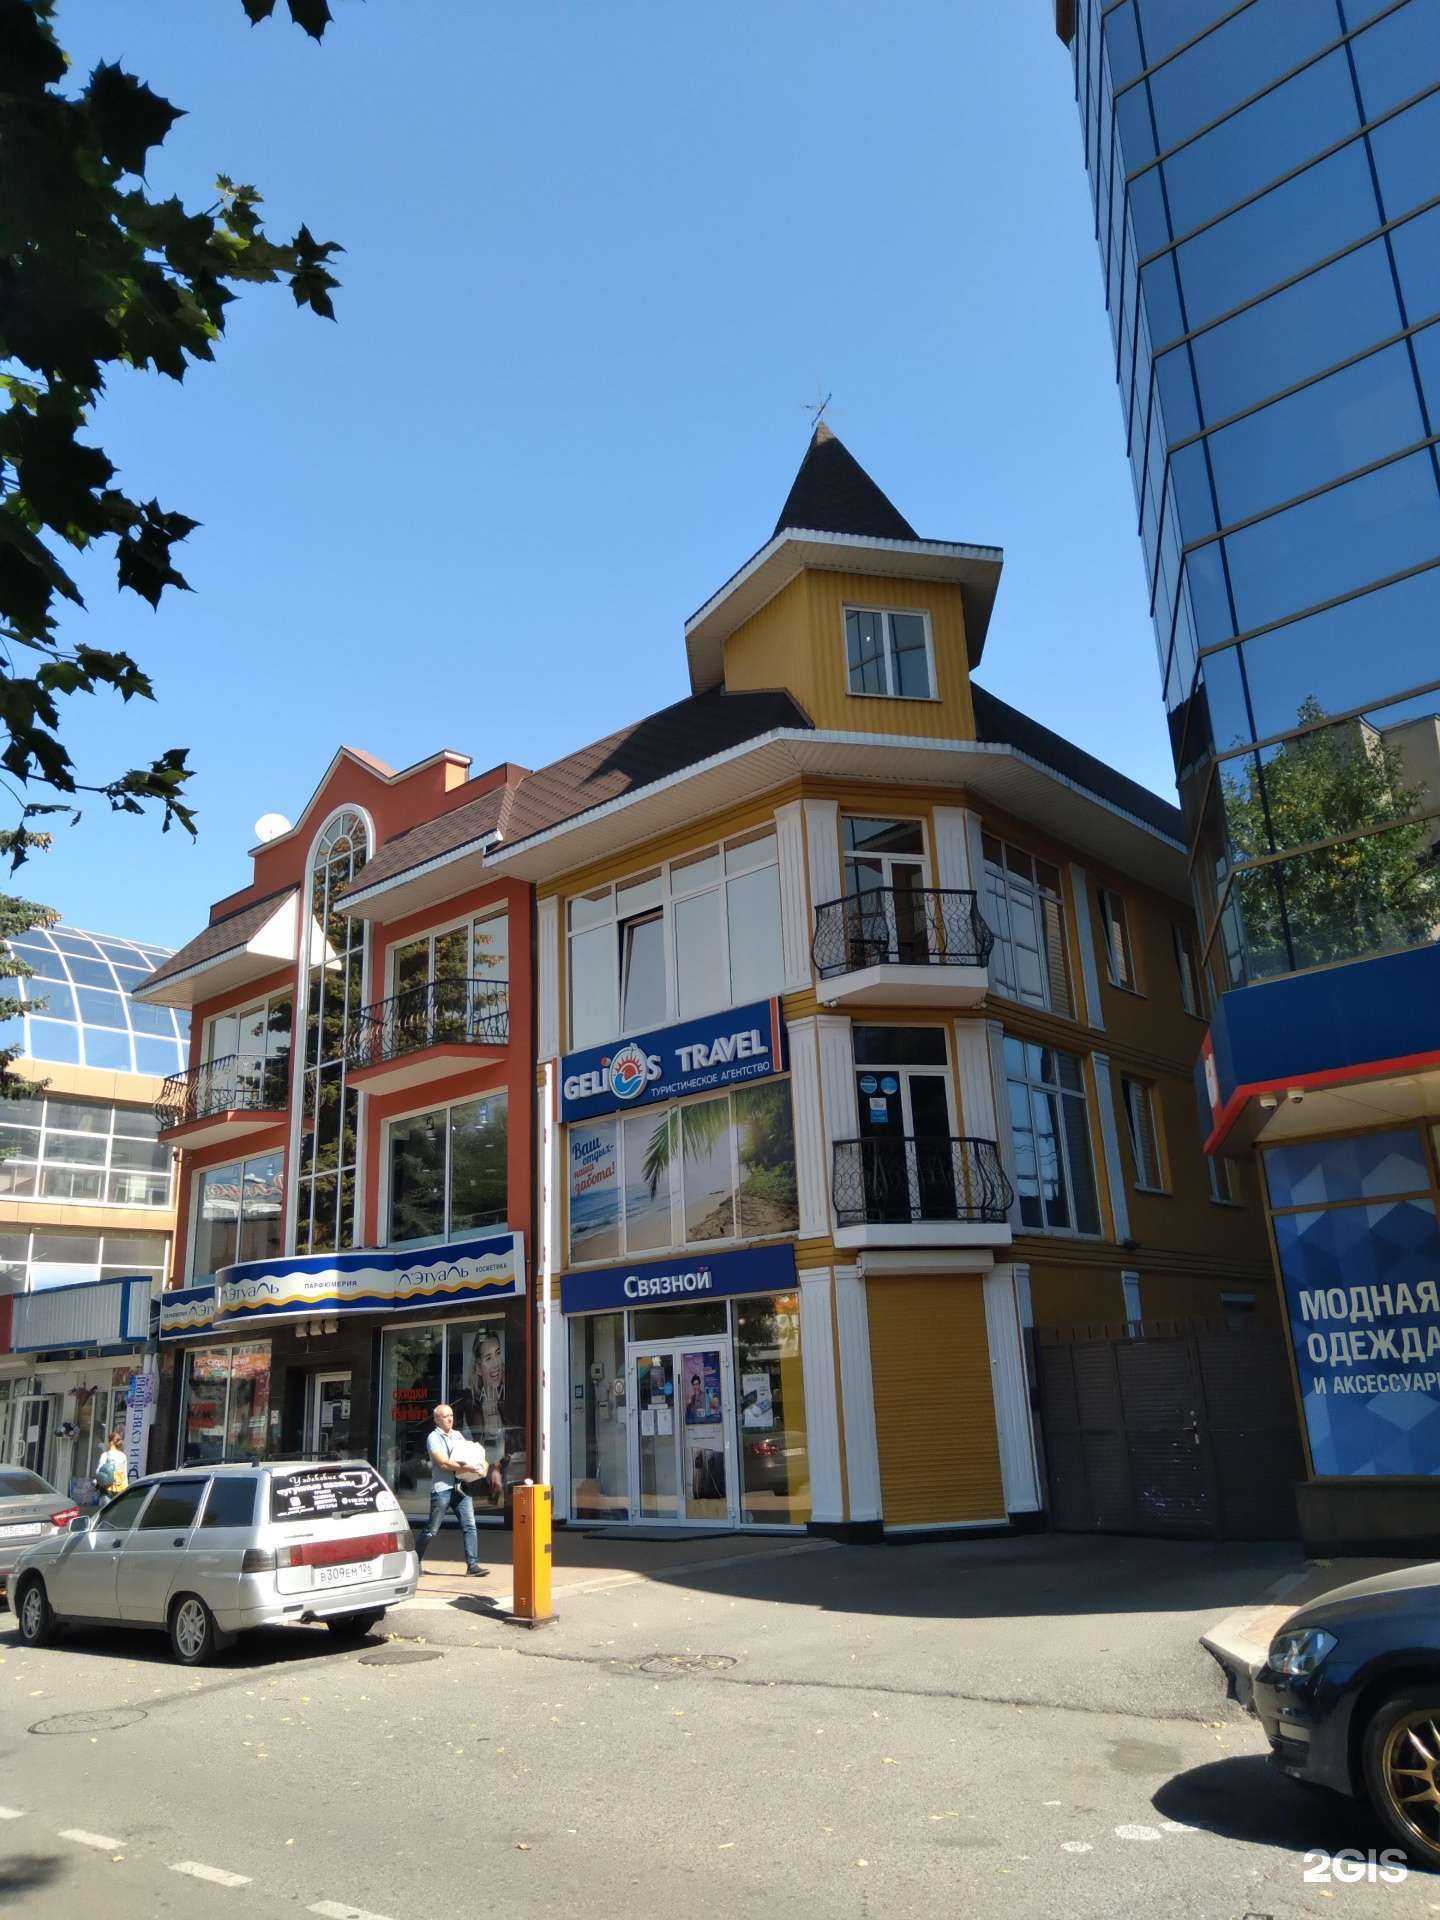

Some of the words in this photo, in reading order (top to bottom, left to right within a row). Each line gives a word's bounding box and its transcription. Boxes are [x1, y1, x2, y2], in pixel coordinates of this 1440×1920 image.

[675, 1029, 768, 1073] TRAVEL
[651, 1074, 718, 1097] ТУРИСТИЧЕСКОЕ
[721, 1061, 770, 1081] АГЕНТСТВО
[572, 1137, 601, 1160] Ваш
[304, 1280, 357, 1289] ПАРФЮМЕРИЯ
[1300, 1280, 1440, 1323] МОДНАЯ
[1307, 1326, 1440, 1367] ОДЕЖДА
[1313, 1377, 1327, 1394] И
[1333, 1371, 1440, 1394] АКСЕССУАР
